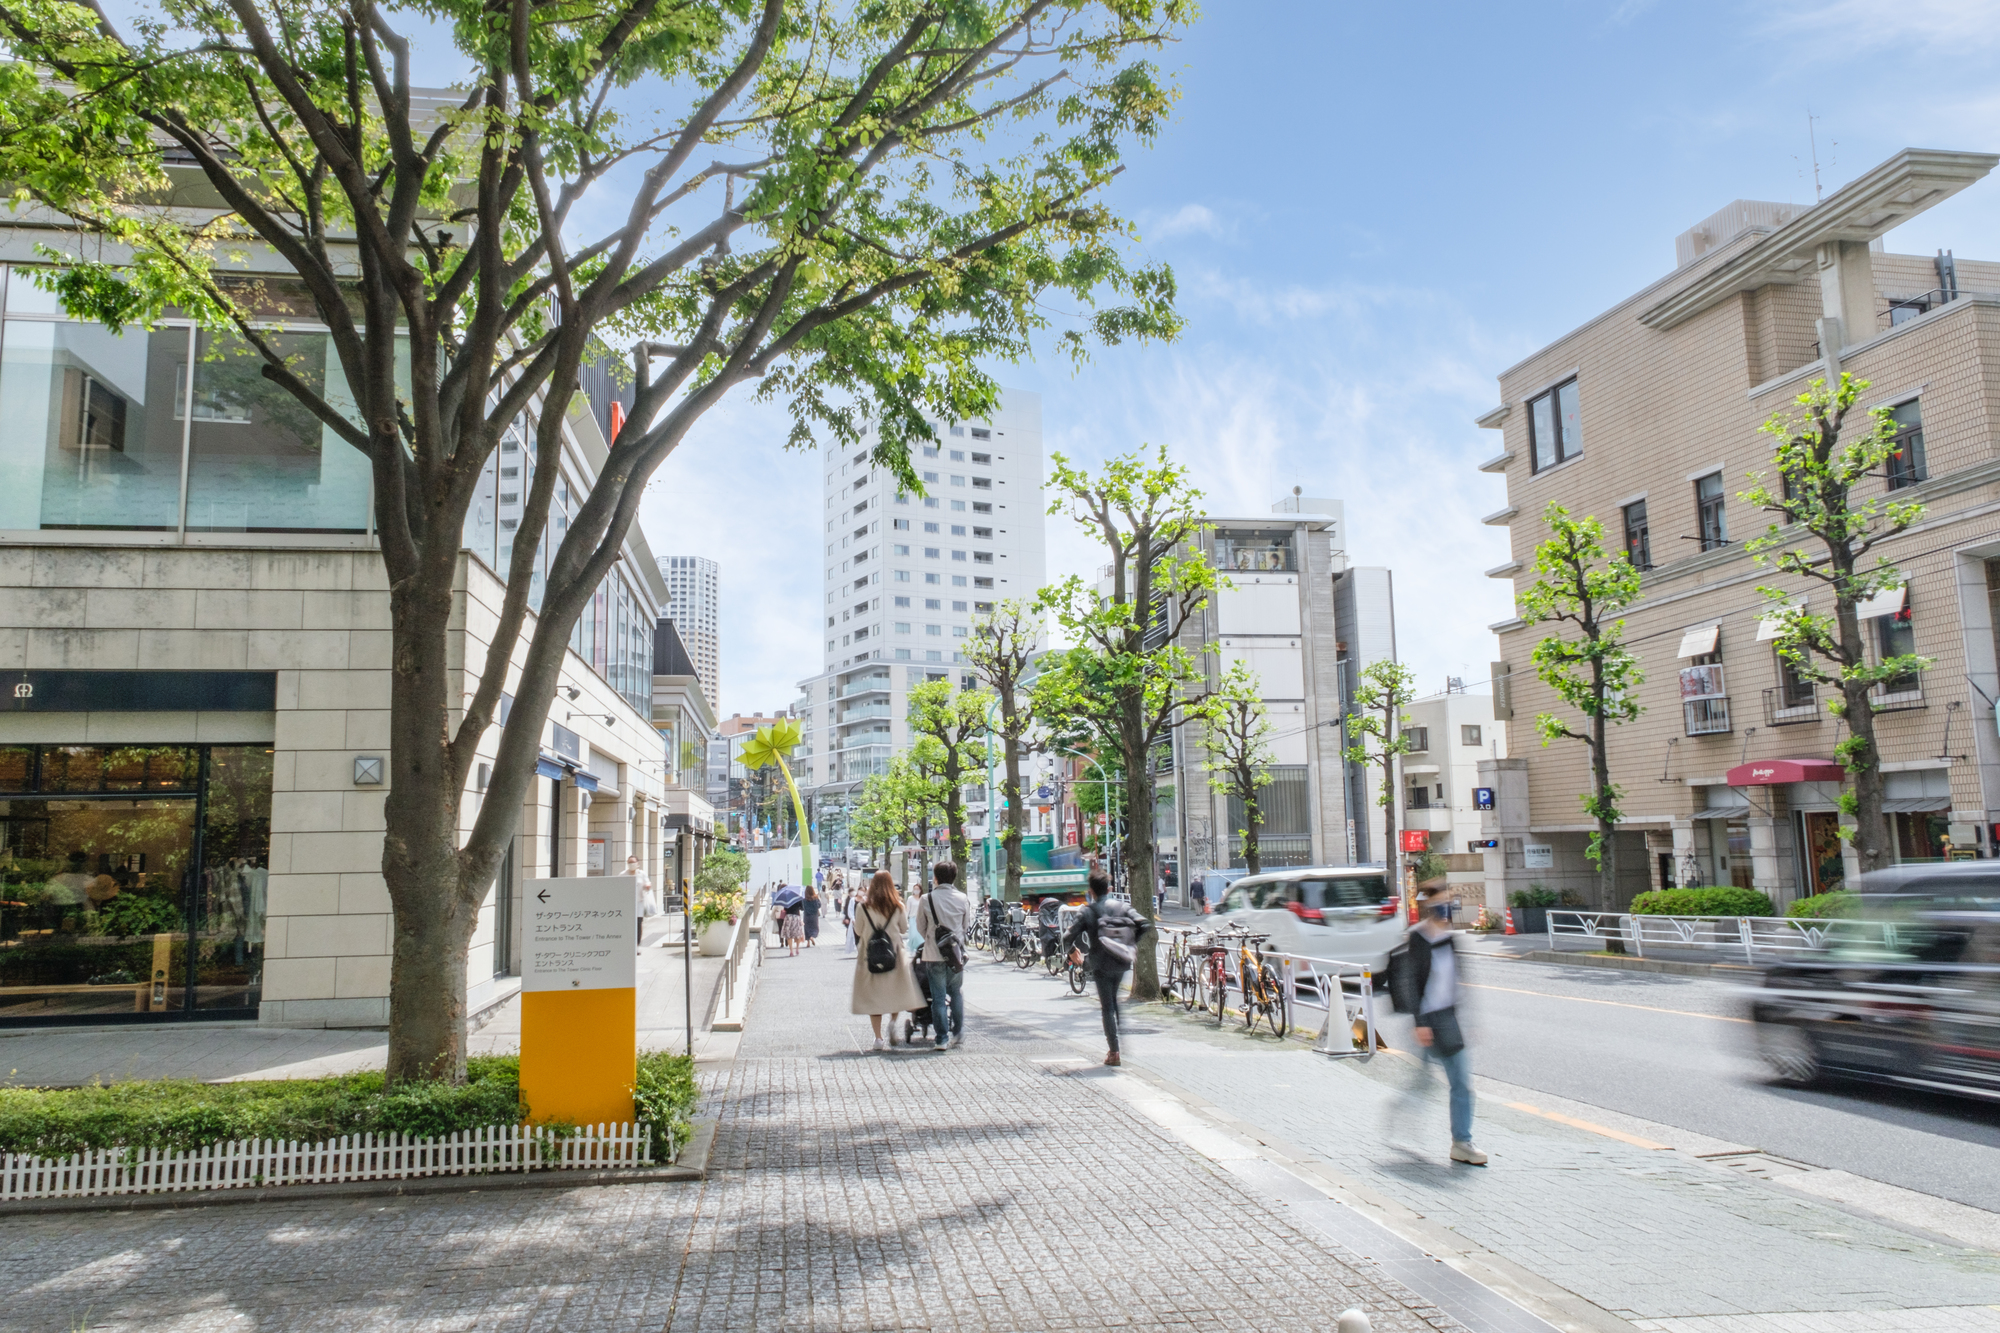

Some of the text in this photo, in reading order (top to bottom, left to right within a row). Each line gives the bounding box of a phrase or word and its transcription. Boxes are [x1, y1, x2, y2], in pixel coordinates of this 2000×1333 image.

[1479, 790, 1490, 803] P
[535, 923, 582, 932] エントランス
[563, 950, 611, 959] クリニックフロア
[535, 960, 574, 968] エントランス
